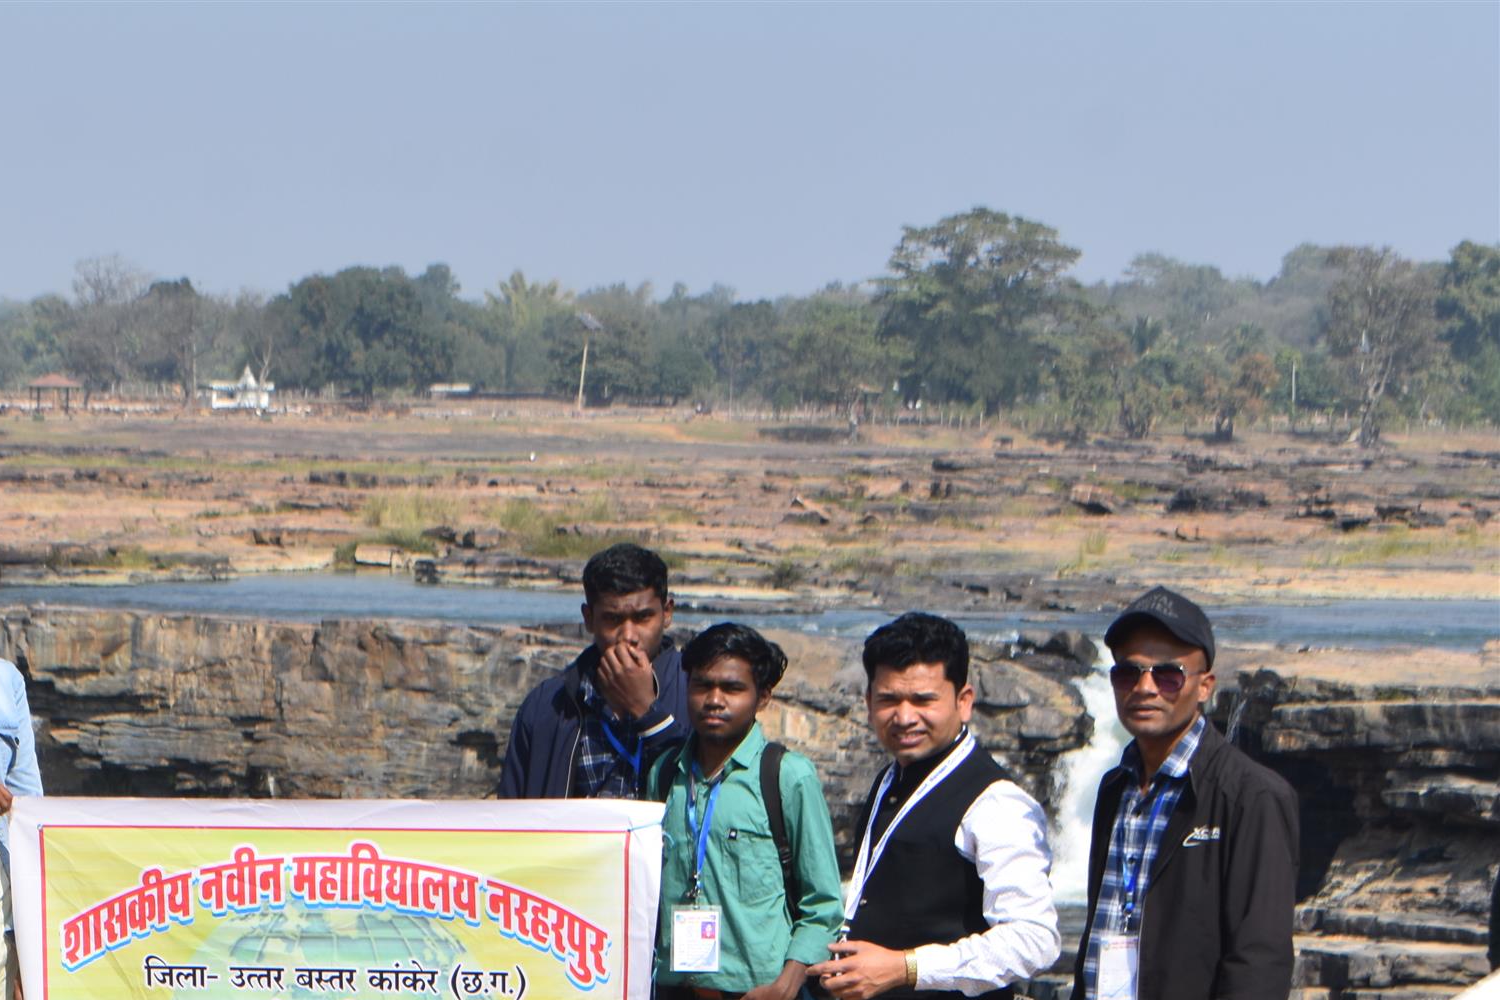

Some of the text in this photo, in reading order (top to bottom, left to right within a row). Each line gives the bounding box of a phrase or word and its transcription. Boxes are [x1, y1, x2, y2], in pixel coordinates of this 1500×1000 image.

[63, 842, 609, 985] शासकीय नवीन महाविद्यालय नरहरपुर
[229, 966, 284, 990] उत्तर
[295, 968, 357, 992] बस्तर
[367, 960, 439, 994] कांकेर
